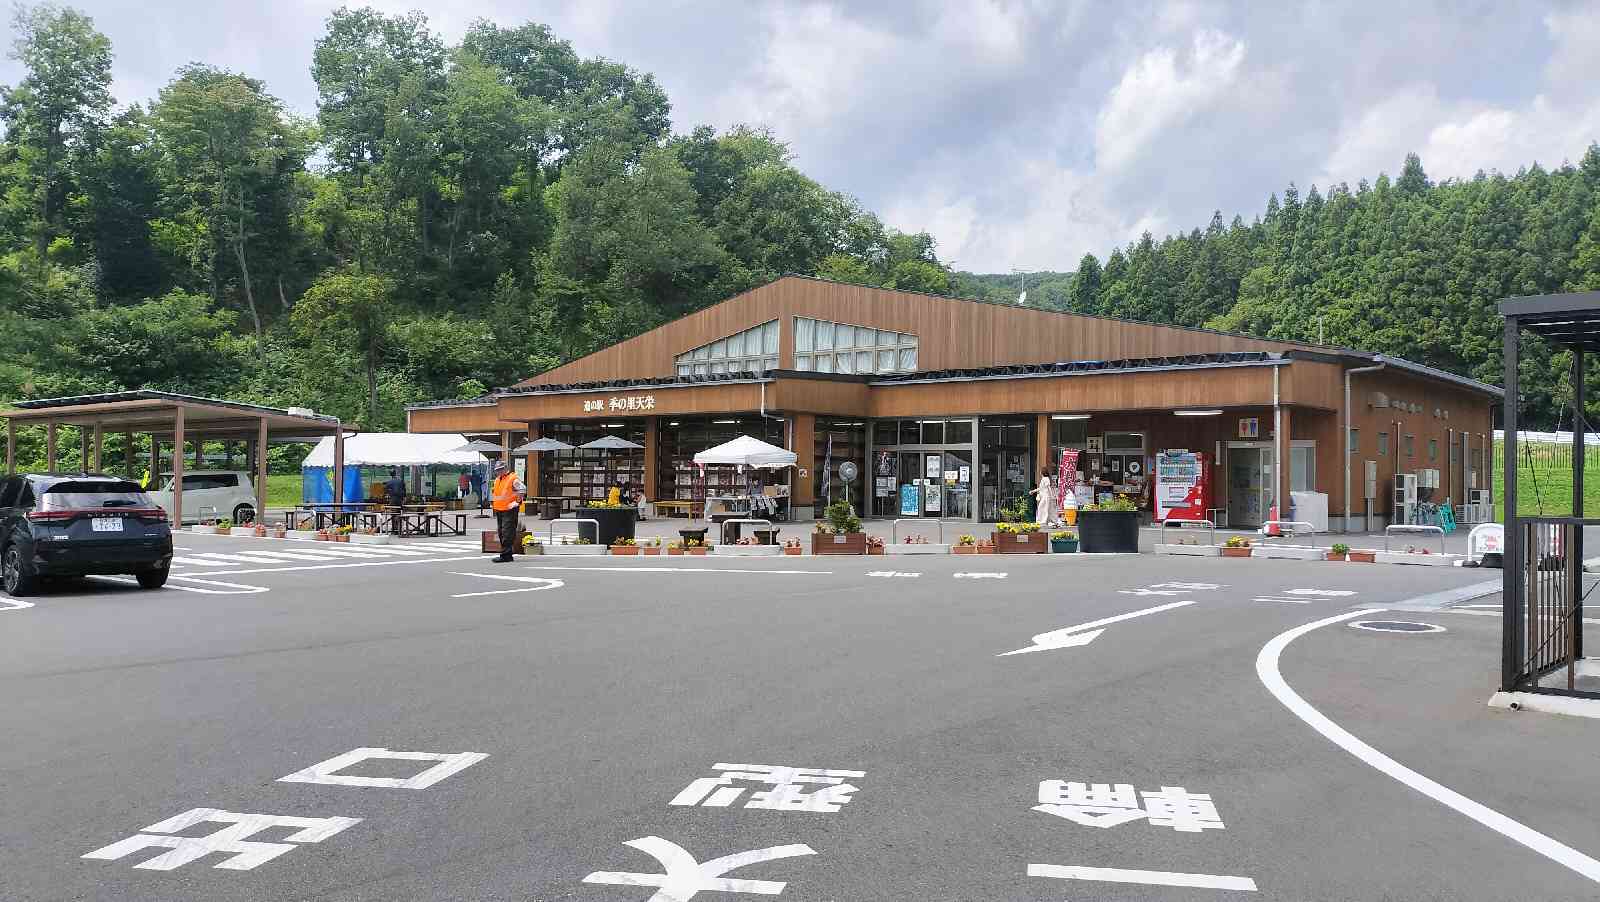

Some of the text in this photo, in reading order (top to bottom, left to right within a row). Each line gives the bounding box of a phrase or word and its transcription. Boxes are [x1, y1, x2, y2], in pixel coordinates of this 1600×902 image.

[608, 395, 656, 411] 季の里天栄
[80, 746, 490, 871] 出口
[581, 762, 867, 902] 大型
